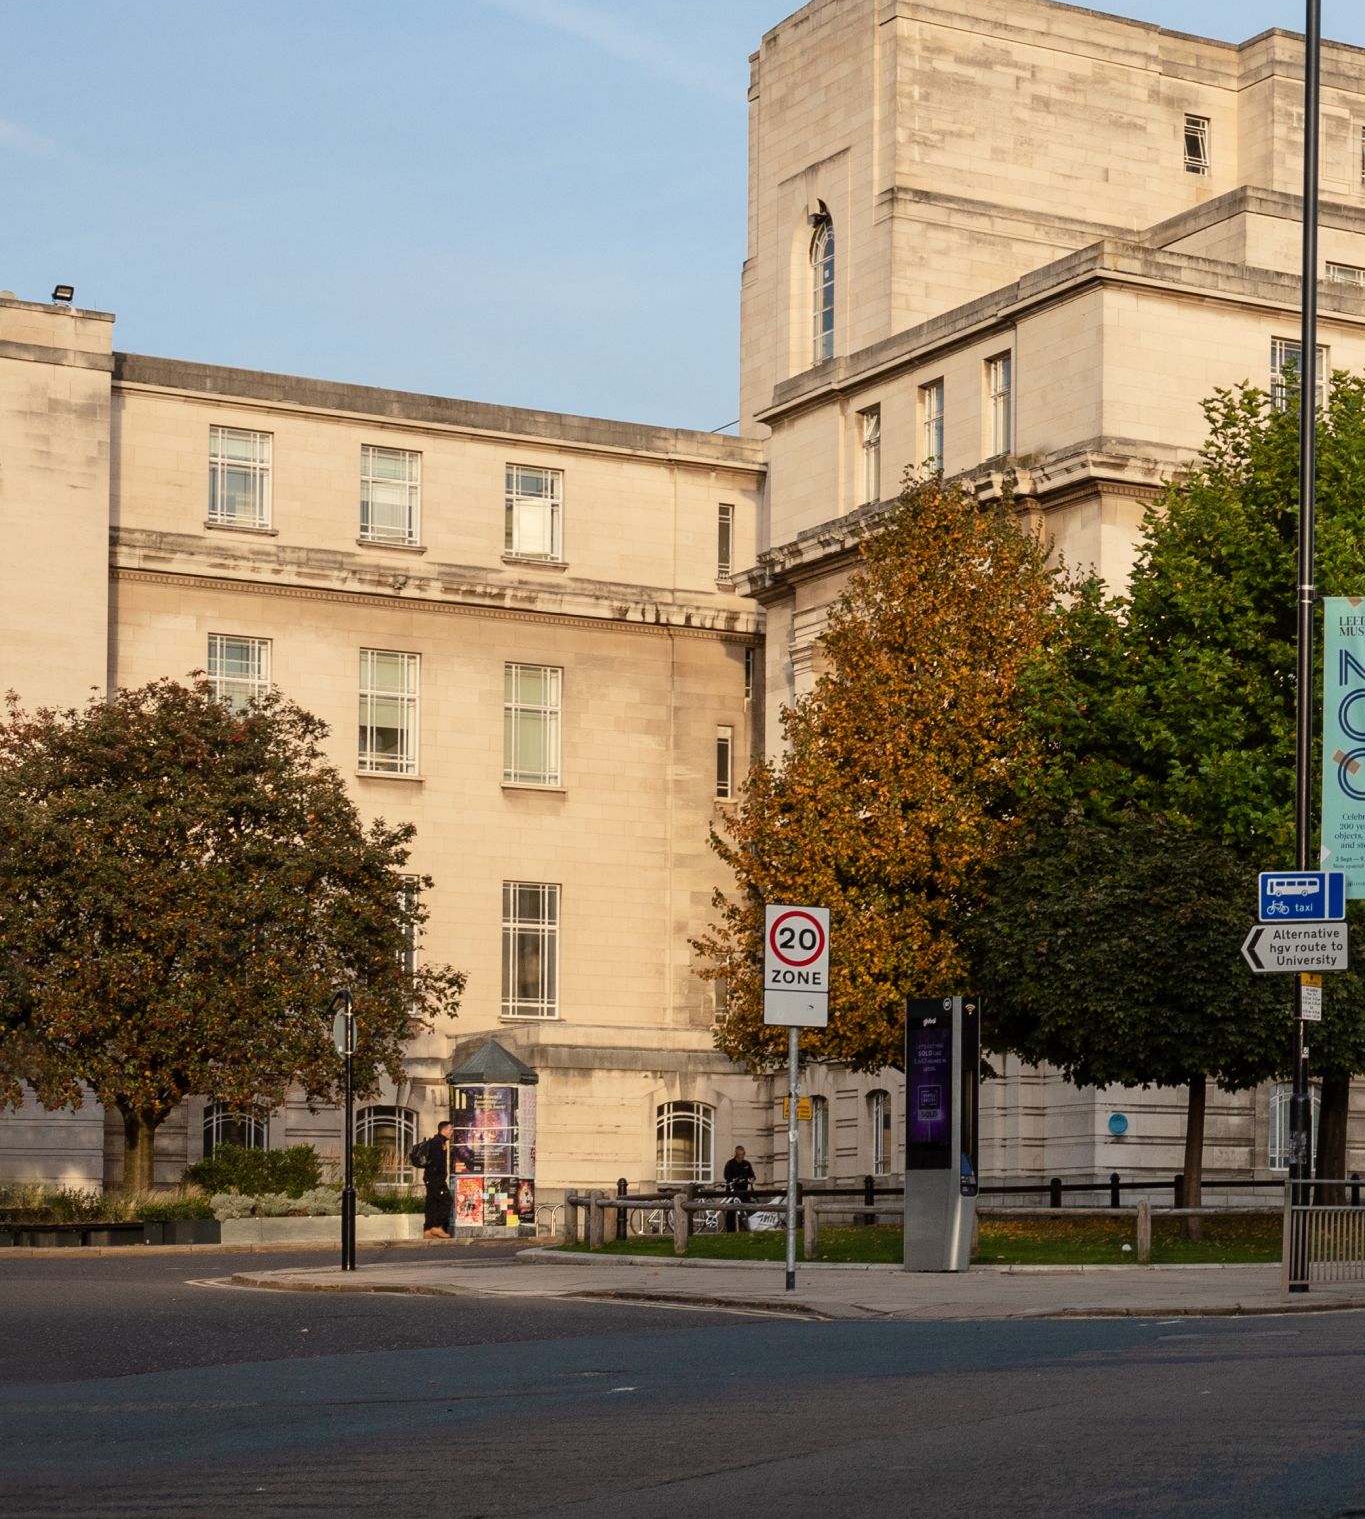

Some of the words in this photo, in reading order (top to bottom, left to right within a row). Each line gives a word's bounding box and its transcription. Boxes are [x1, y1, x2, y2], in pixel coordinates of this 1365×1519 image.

[1334, 832, 1363, 840] objects,
[1340, 841, 1355, 849] and
[1295, 902, 1313, 912] taxi
[779, 927, 817, 951] 20
[1273, 928, 1340, 940] Alternative
[1269, 943, 1291, 955] hgv
[1295, 942, 1327, 953] route
[1331, 941, 1344, 951] to
[1276, 954, 1337, 966] University
[771, 969, 822, 986] ZONE
